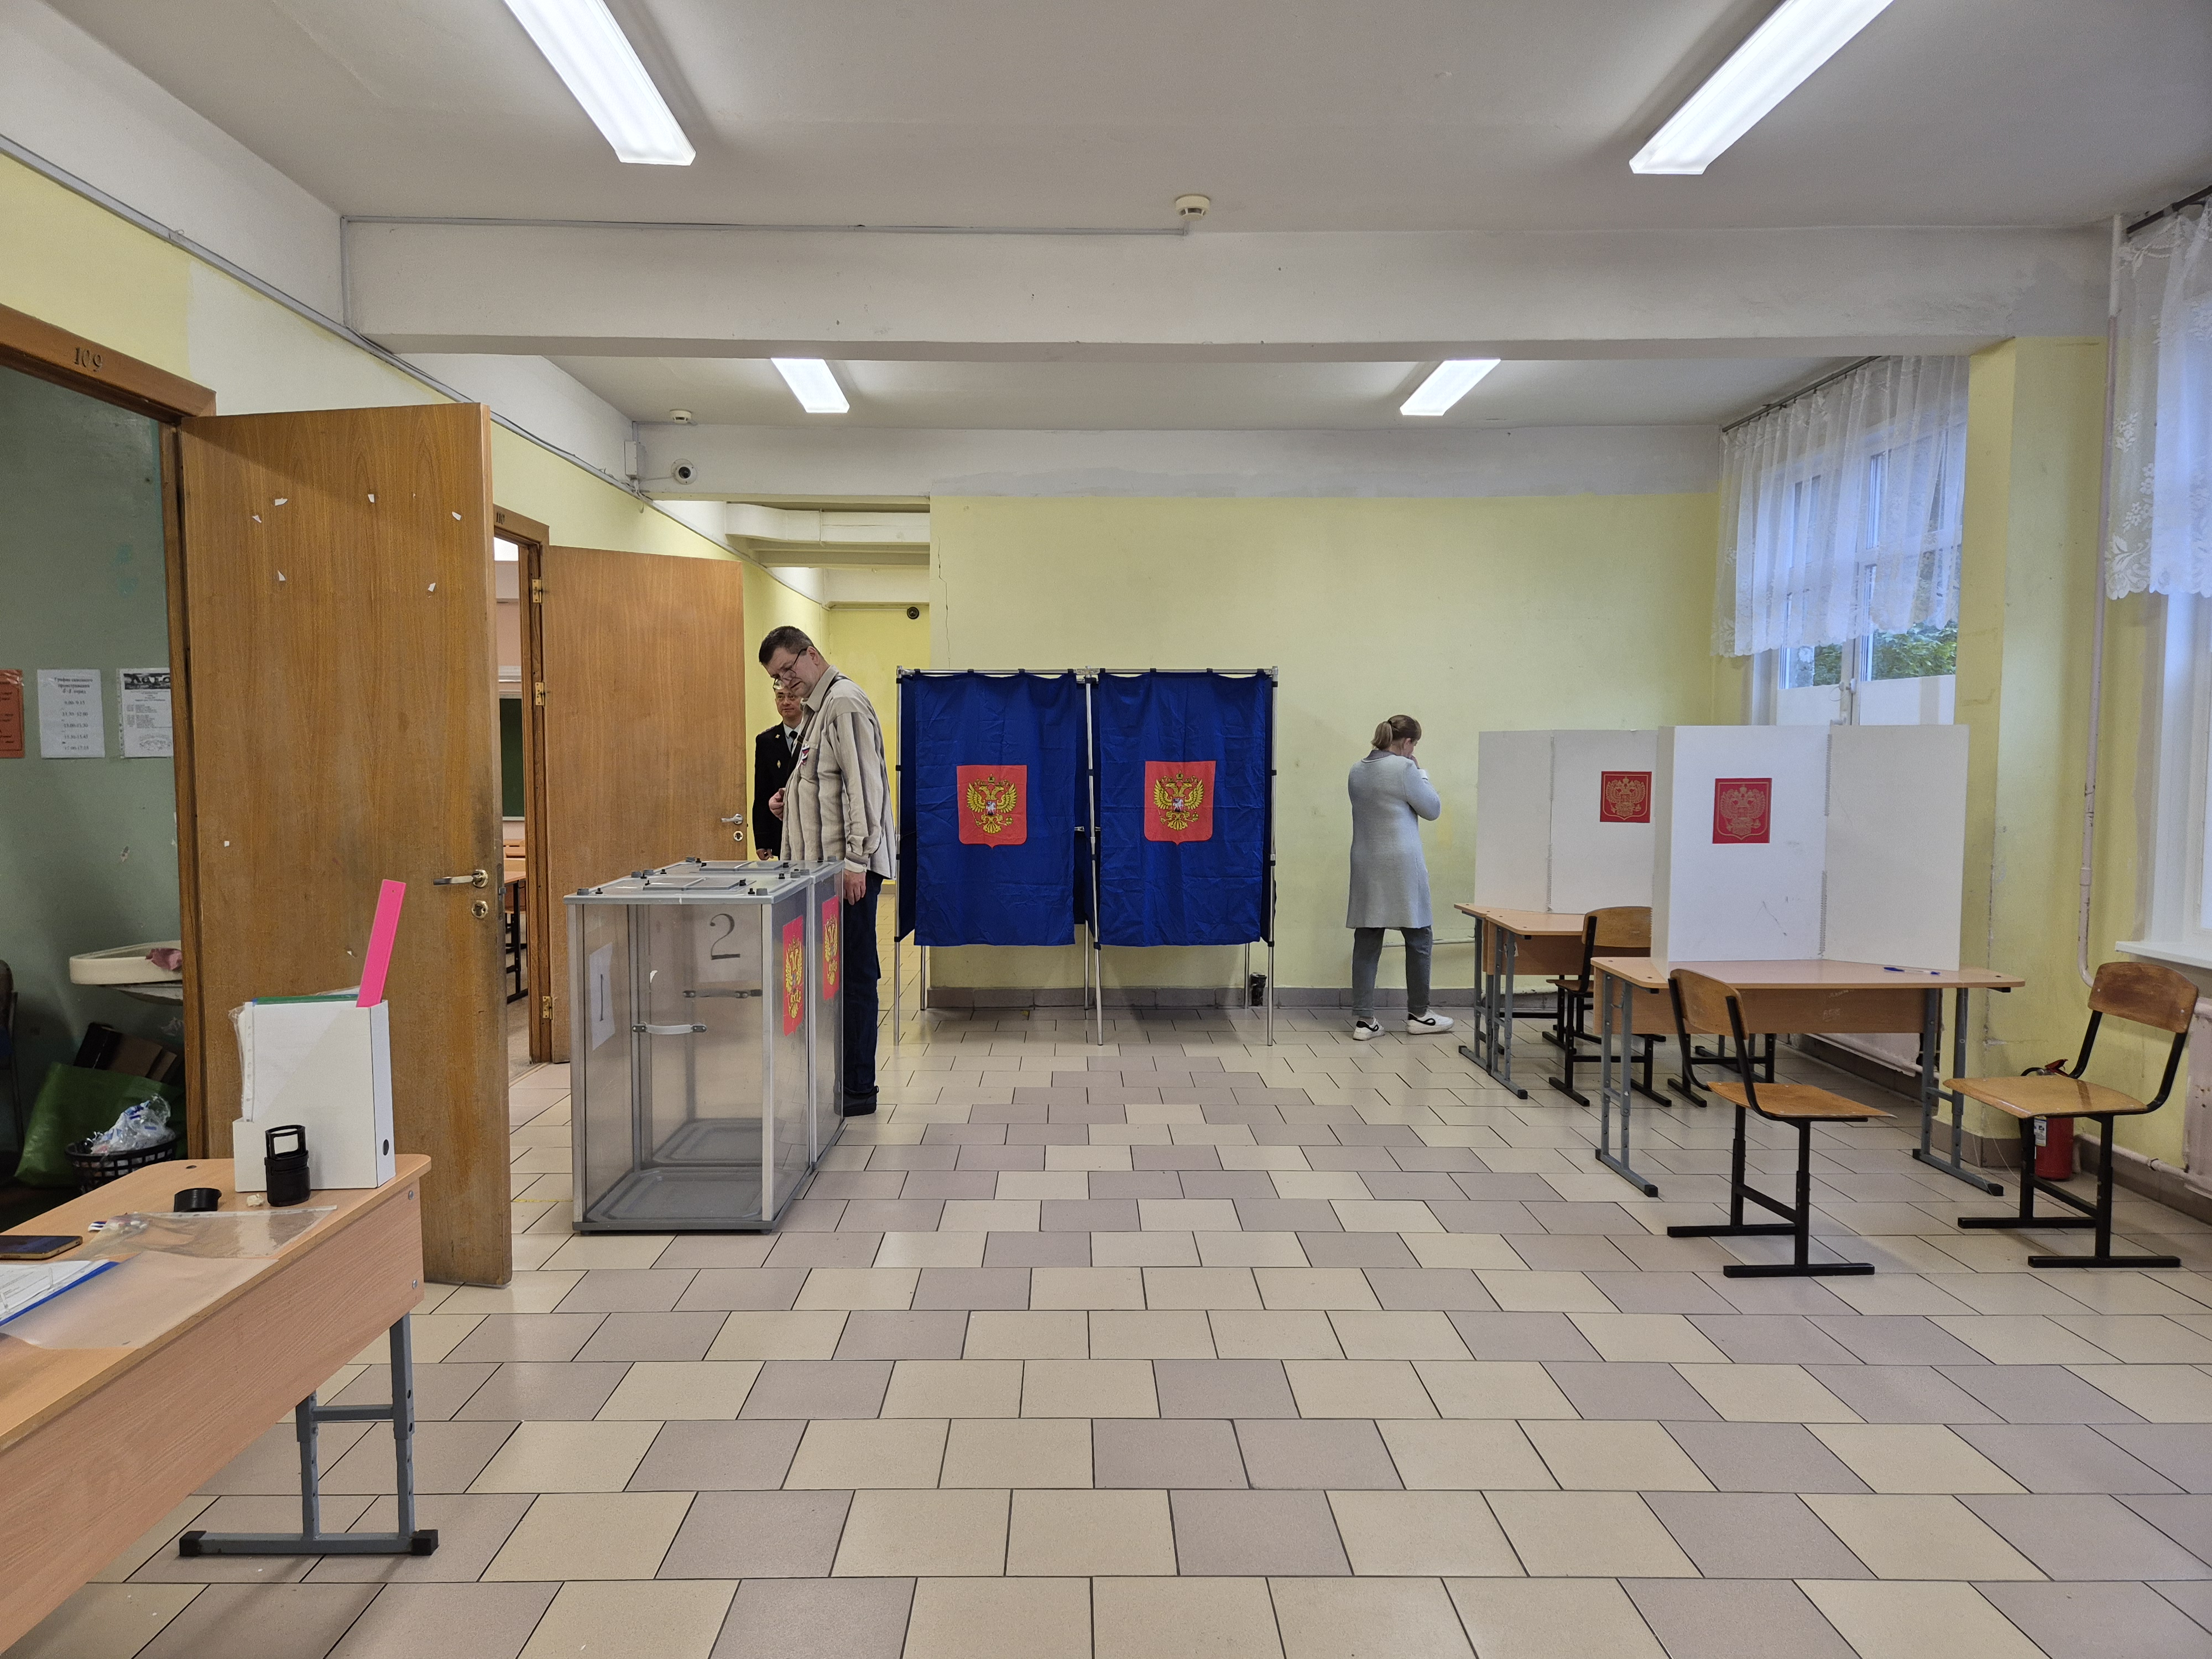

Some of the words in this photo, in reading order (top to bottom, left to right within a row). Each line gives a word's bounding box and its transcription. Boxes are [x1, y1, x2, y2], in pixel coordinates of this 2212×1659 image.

[74, 347, 103, 372] 109
[709, 914, 740, 960] 2
[599, 974, 604, 1021] 1
